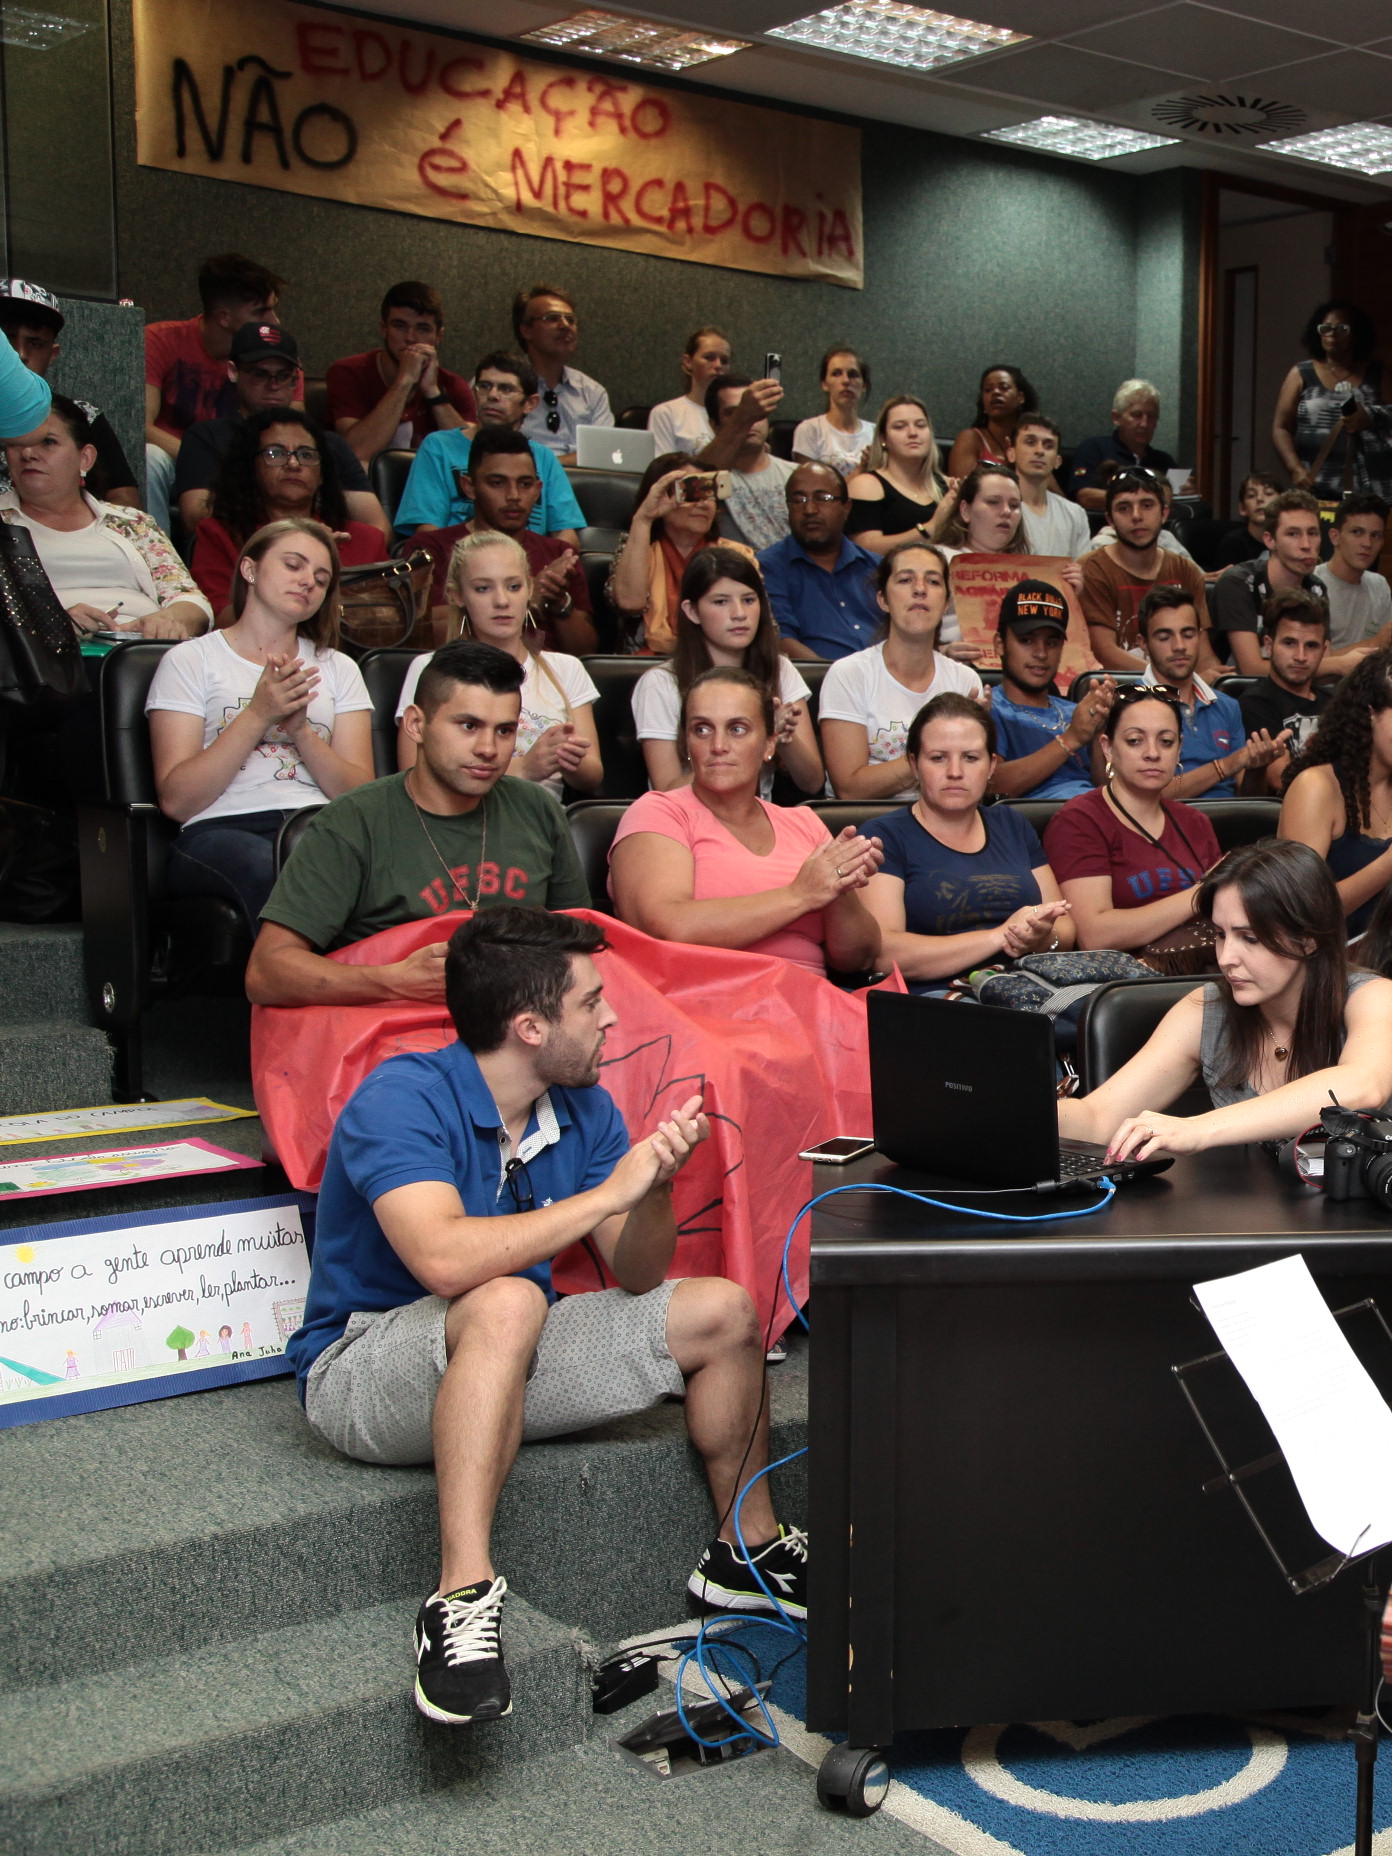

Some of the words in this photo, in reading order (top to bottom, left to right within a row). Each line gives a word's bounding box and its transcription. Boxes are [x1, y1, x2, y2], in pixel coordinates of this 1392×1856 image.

[301, 22, 674, 141] EDUCAÇÃO
[171, 55, 360, 172] NÃO
[511, 149, 856, 258] MERCADORIA
[1017, 604, 1038, 617] NEW
[1043, 607, 1064, 618] YORK
[1018, 592, 1042, 602] BLACK
[418, 861, 529, 915] UFSC
[944, 1081, 973, 1092] POSITIVO
[4, 1265, 64, 1296] campo
[70, 1264, 93, 1280] a
[104, 1243, 150, 1285] gente
[160, 1229, 232, 1275] aprende
[236, 1221, 305, 1254] muitas
[231, 1350, 253, 1361] Ana
